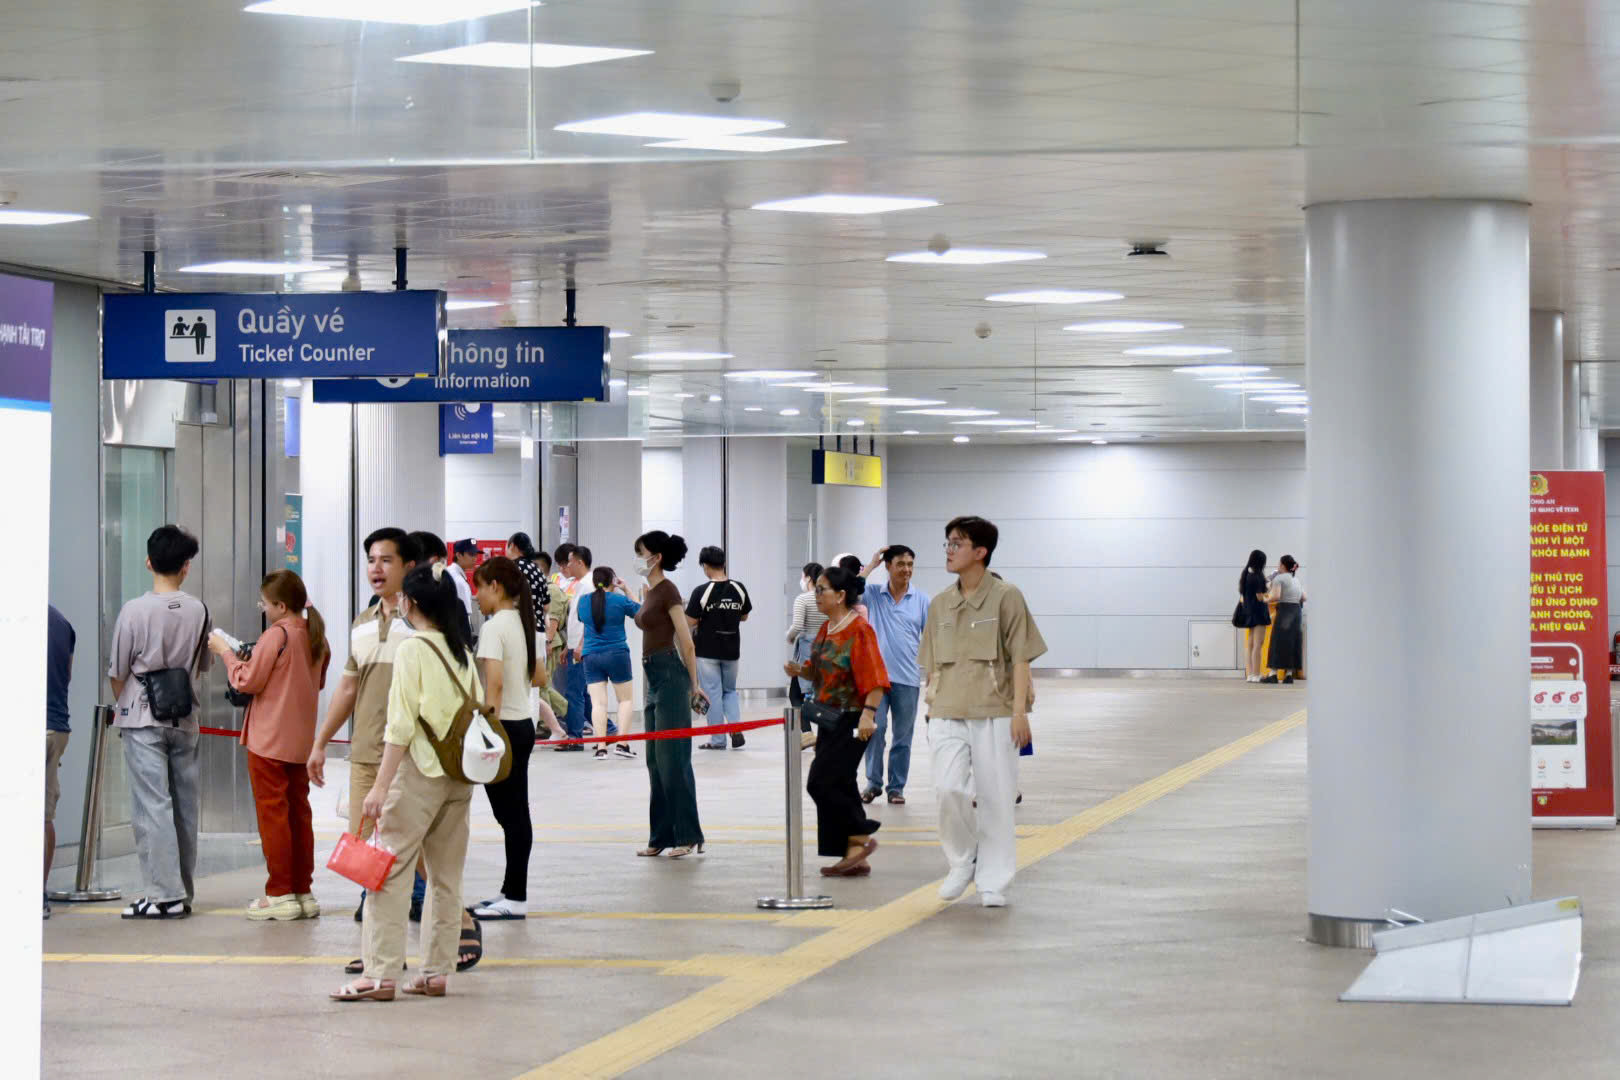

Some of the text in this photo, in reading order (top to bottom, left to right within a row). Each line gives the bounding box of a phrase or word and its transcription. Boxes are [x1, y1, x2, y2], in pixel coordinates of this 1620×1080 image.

[238, 305, 345, 340] Quầy vé
[238, 343, 376, 362] Ticket Counter
[447, 341, 545, 369] hông tin
[1530, 521, 1550, 533] HỎE
[1551, 522, 1575, 534] ĐIỆN
[1563, 534, 1585, 547] MỘT
[1560, 547, 1590, 559] MẠNH
[1564, 573, 1585, 583] TỤC
[1559, 585, 1583, 596] LỊCH
[706, 602, 743, 612] HAVEN
[1569, 598, 1599, 608] DỤNG
[1530, 610, 1551, 619] ANH
[1539, 621, 1562, 632] HIỆU
[1563, 620, 1586, 632] QUẢ
